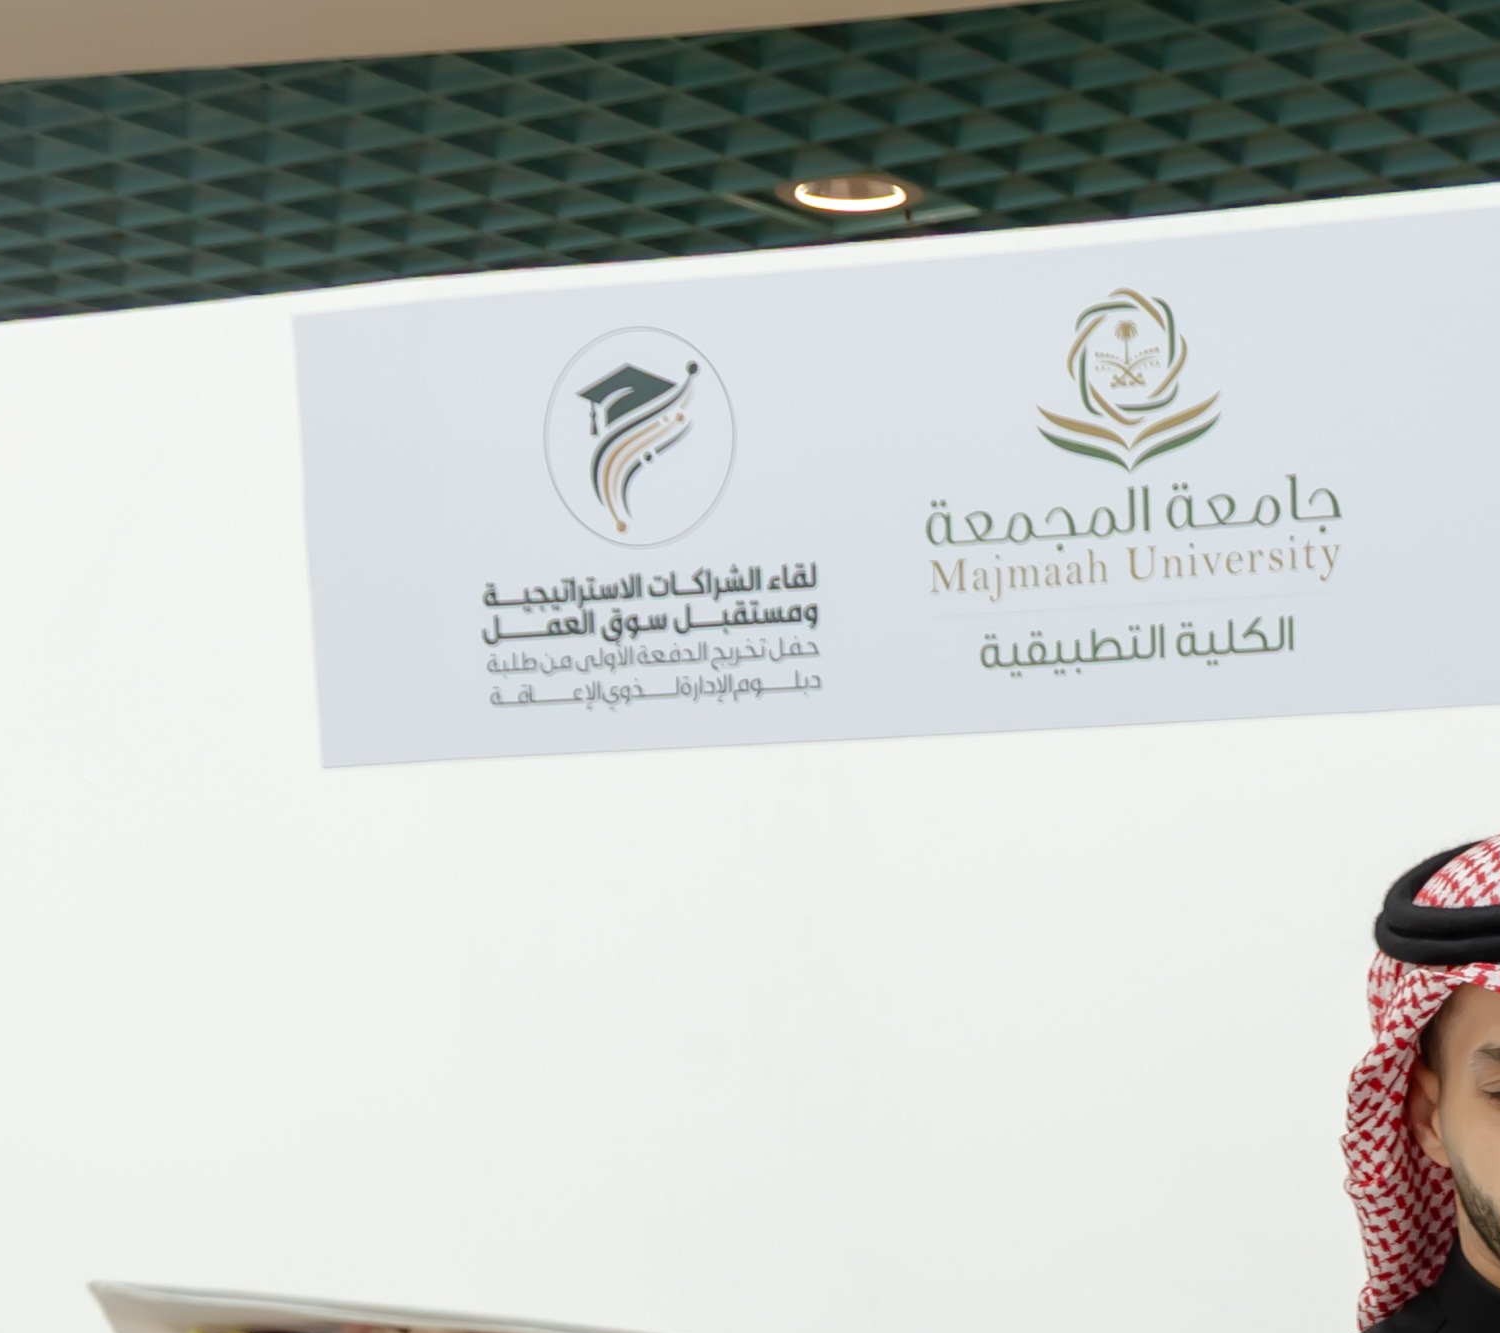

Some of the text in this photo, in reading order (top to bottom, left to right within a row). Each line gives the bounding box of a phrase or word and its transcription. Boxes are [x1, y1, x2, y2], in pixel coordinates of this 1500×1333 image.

[925, 473, 1342, 551] جامعة المجمعة
[929, 535, 1342, 602] Majmaah University
[482, 561, 818, 612] لقاء الشراكات الاستراتيجية
[482, 600, 819, 645] ومستقبل سوق العمل
[637, 642, 709, 666] الدفعة
[710, 638, 768, 670] تخريج
[768, 636, 821, 662] حفل
[979, 614, 1295, 679] الكلية التطبيقية
[485, 651, 538, 678] طلبة
[540, 652, 574, 675] من
[681, 674, 733, 704] الإدارة
